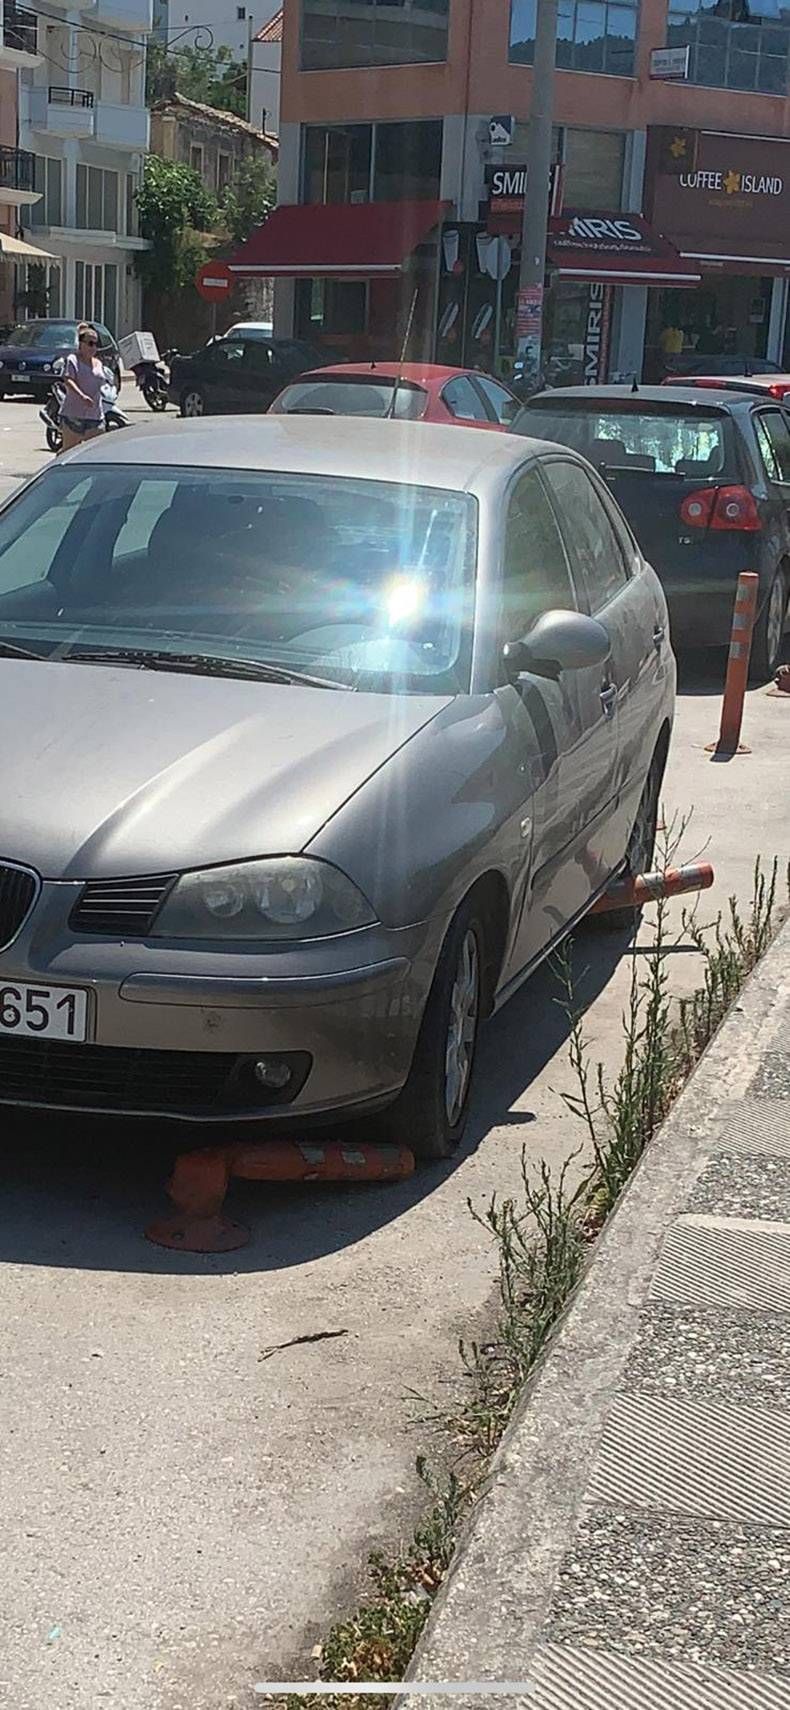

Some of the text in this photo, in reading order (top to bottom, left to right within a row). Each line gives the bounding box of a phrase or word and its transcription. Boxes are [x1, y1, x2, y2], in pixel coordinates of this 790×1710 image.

[679, 171, 783, 195] COFFEE ISLAND
[0, 987, 75, 1035] 651
